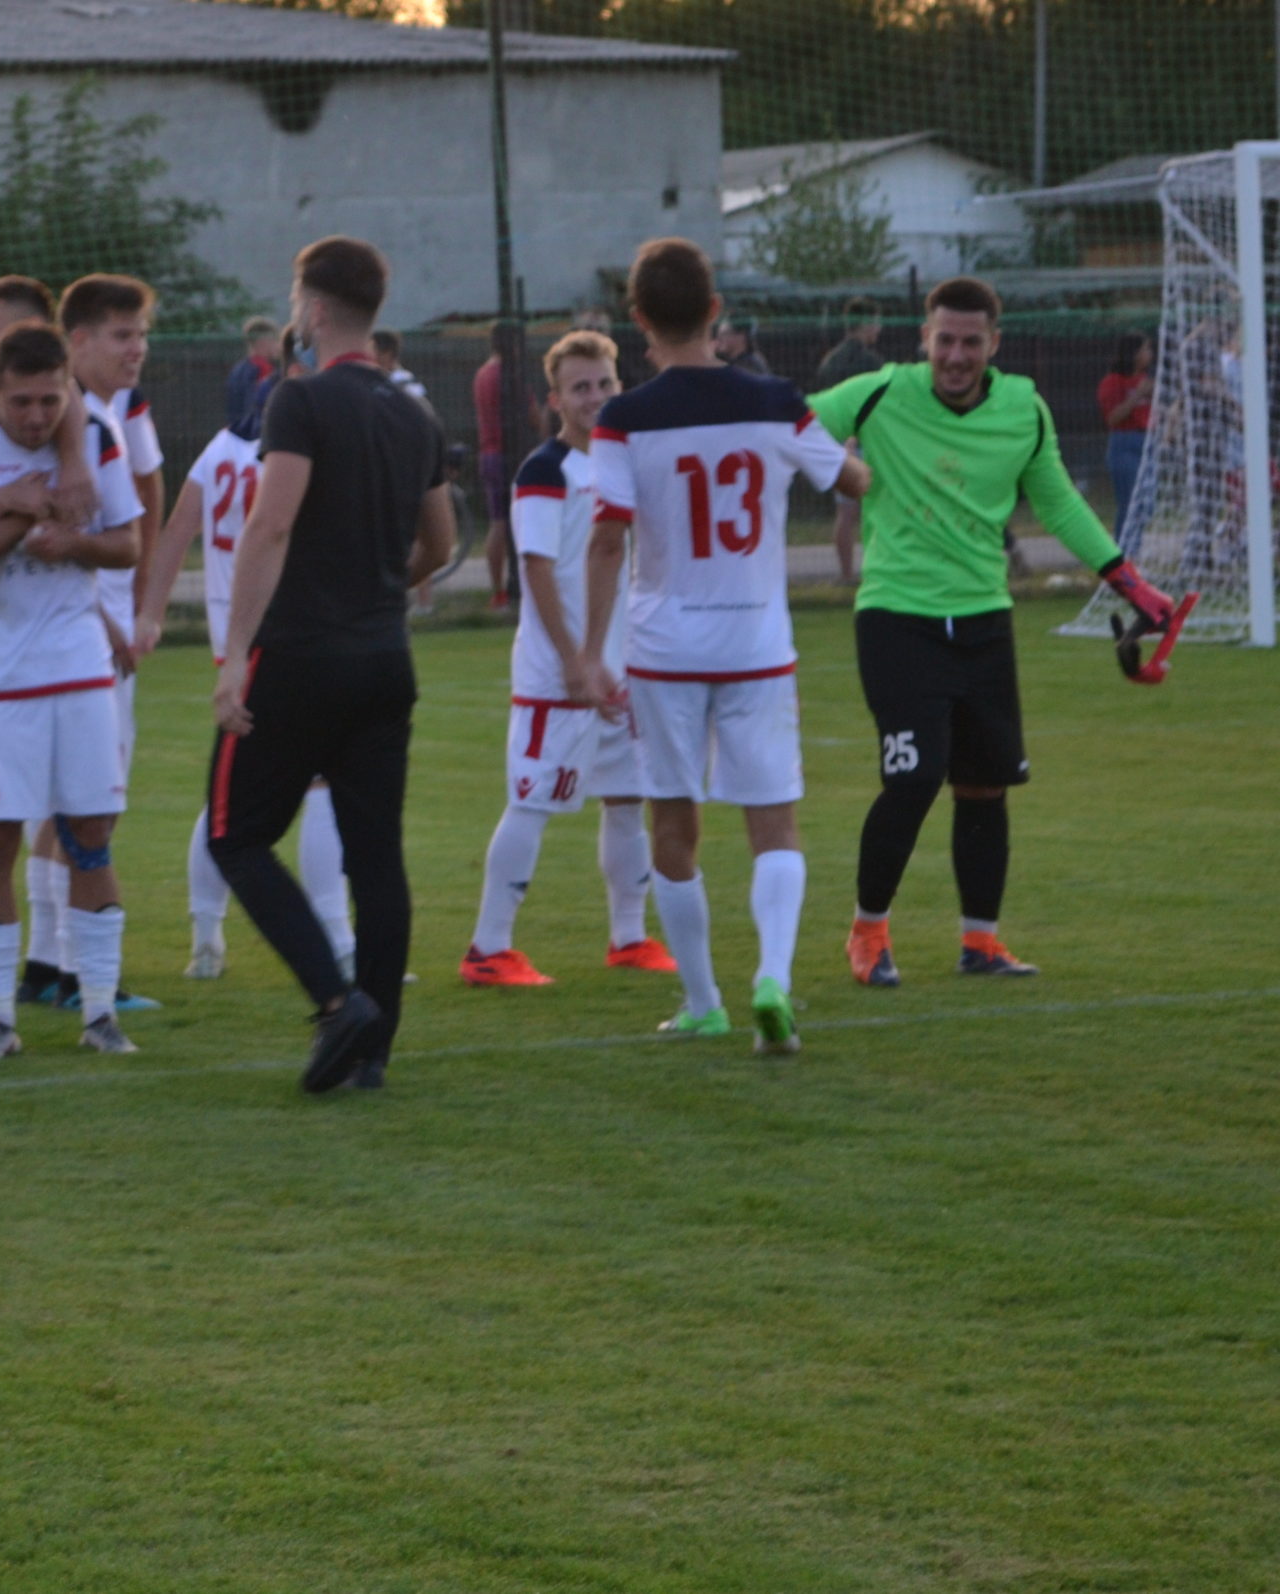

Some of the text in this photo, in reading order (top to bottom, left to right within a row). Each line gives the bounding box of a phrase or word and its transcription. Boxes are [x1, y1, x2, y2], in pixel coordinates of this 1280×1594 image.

[676, 449, 764, 559] 13
[883, 731, 919, 774] 25
[550, 766, 578, 802] 10
